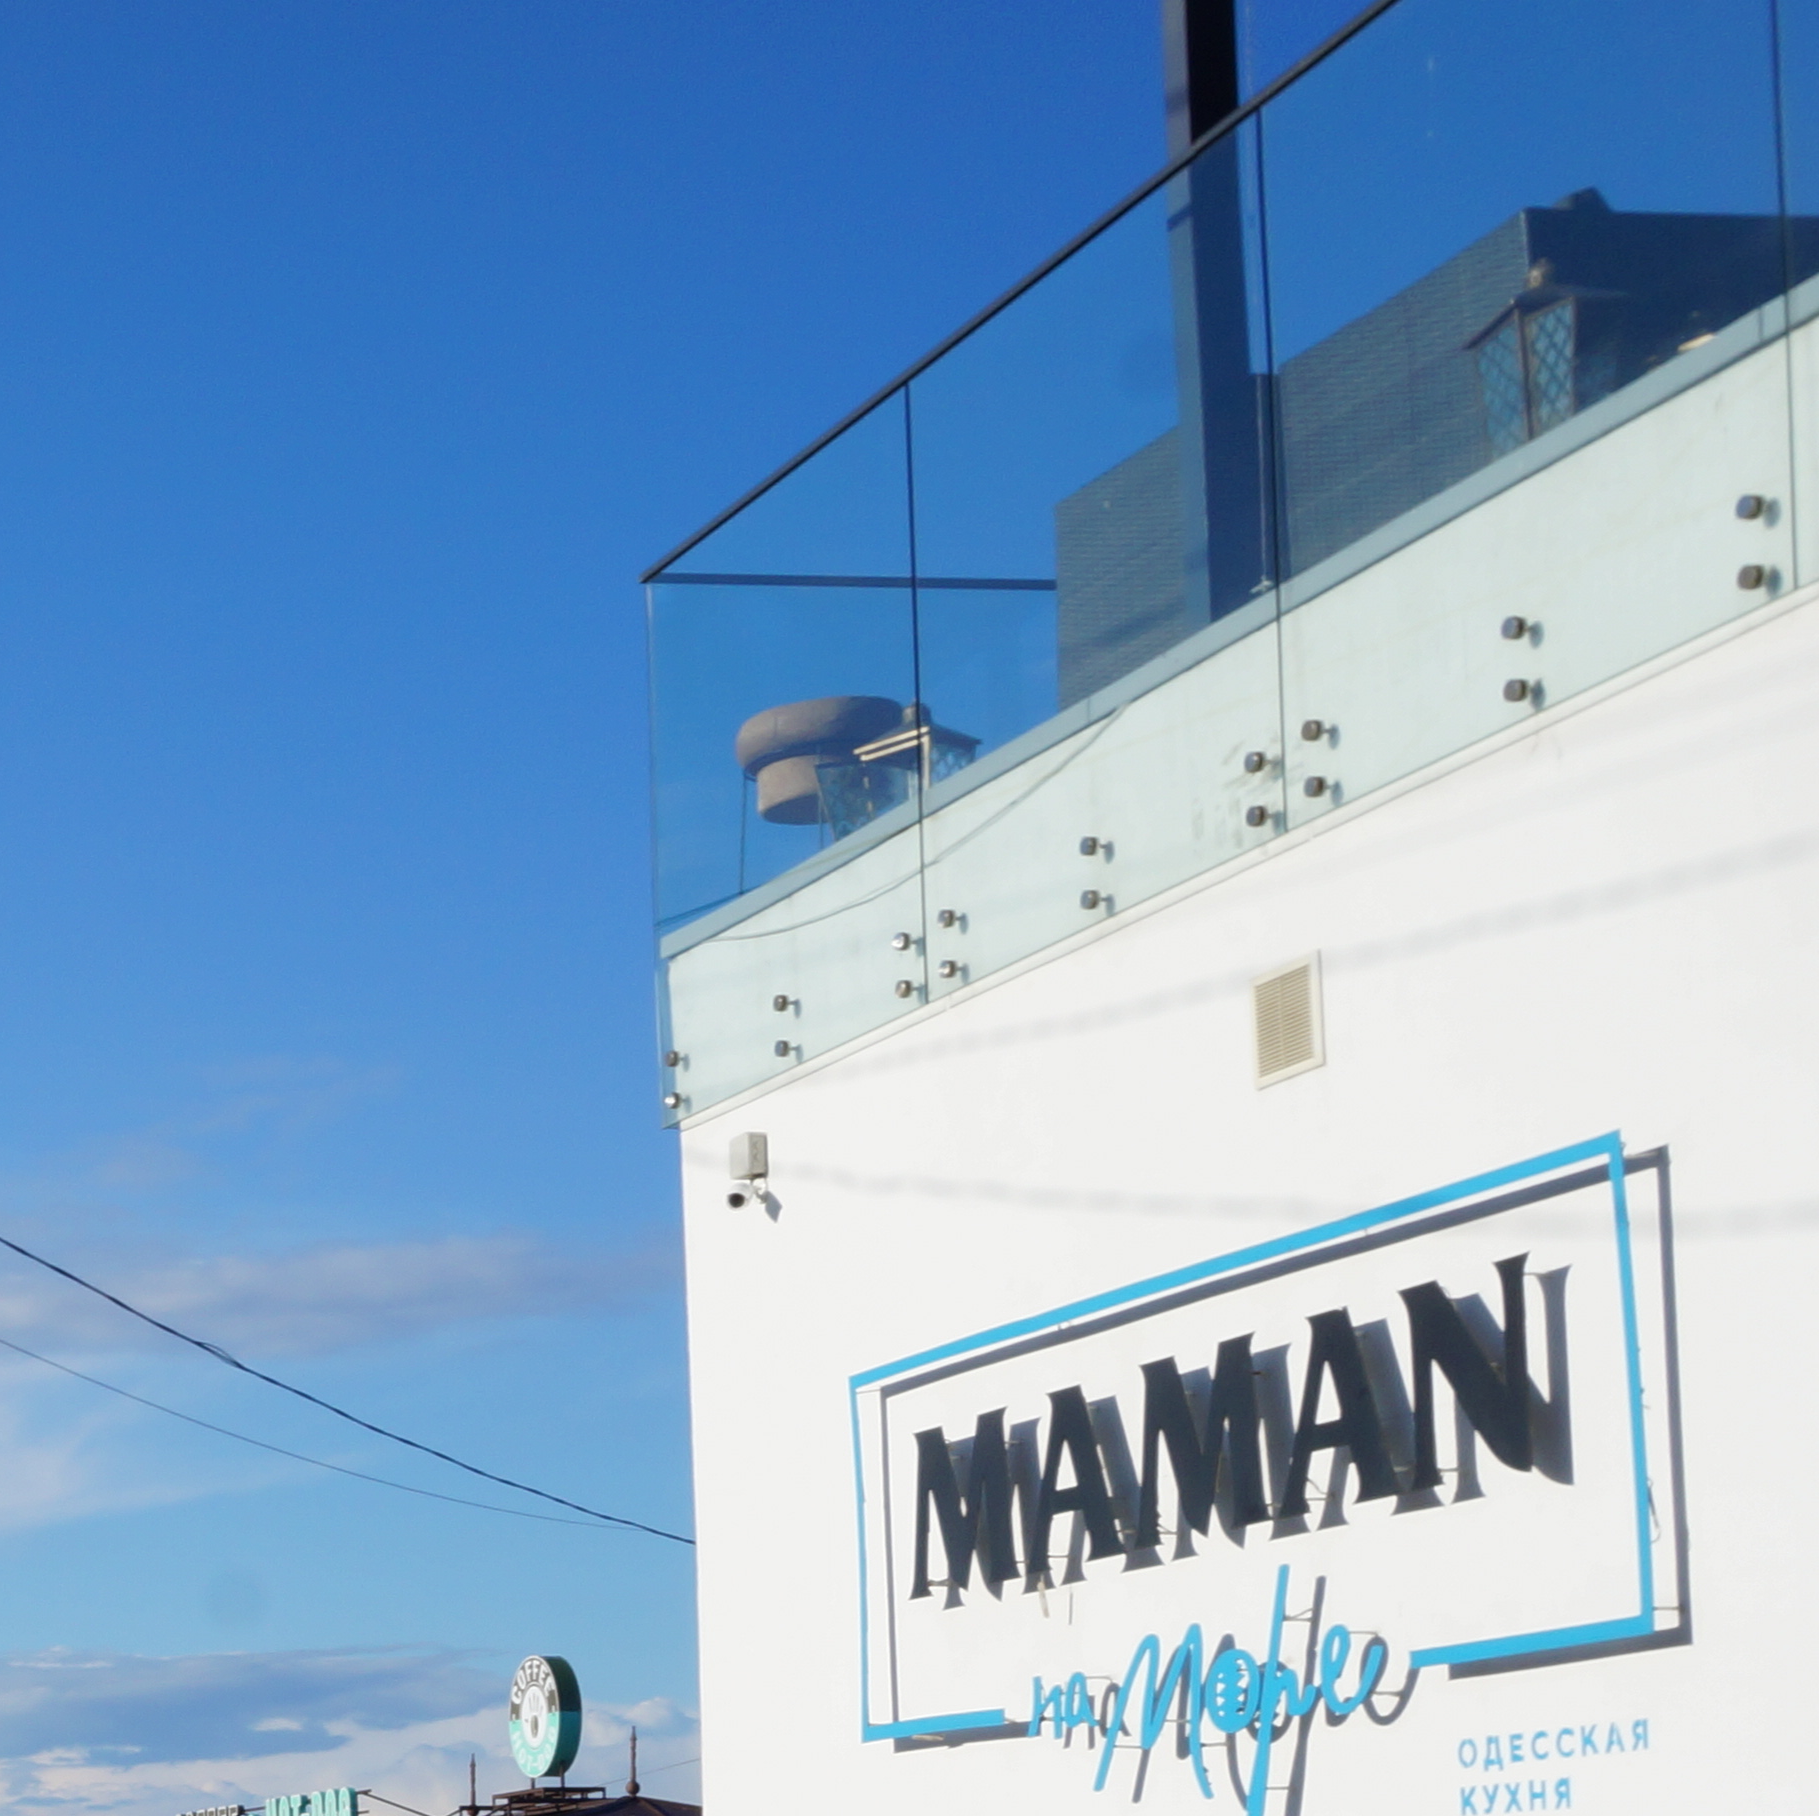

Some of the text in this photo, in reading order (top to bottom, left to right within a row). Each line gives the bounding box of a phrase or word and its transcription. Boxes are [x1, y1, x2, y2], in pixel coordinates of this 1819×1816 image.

[908, 1251, 1531, 1601] MAMAN
[511, 1659, 556, 1705] COFFEE
[1457, 1718, 1651, 1772] ОДЕССКАЯ
